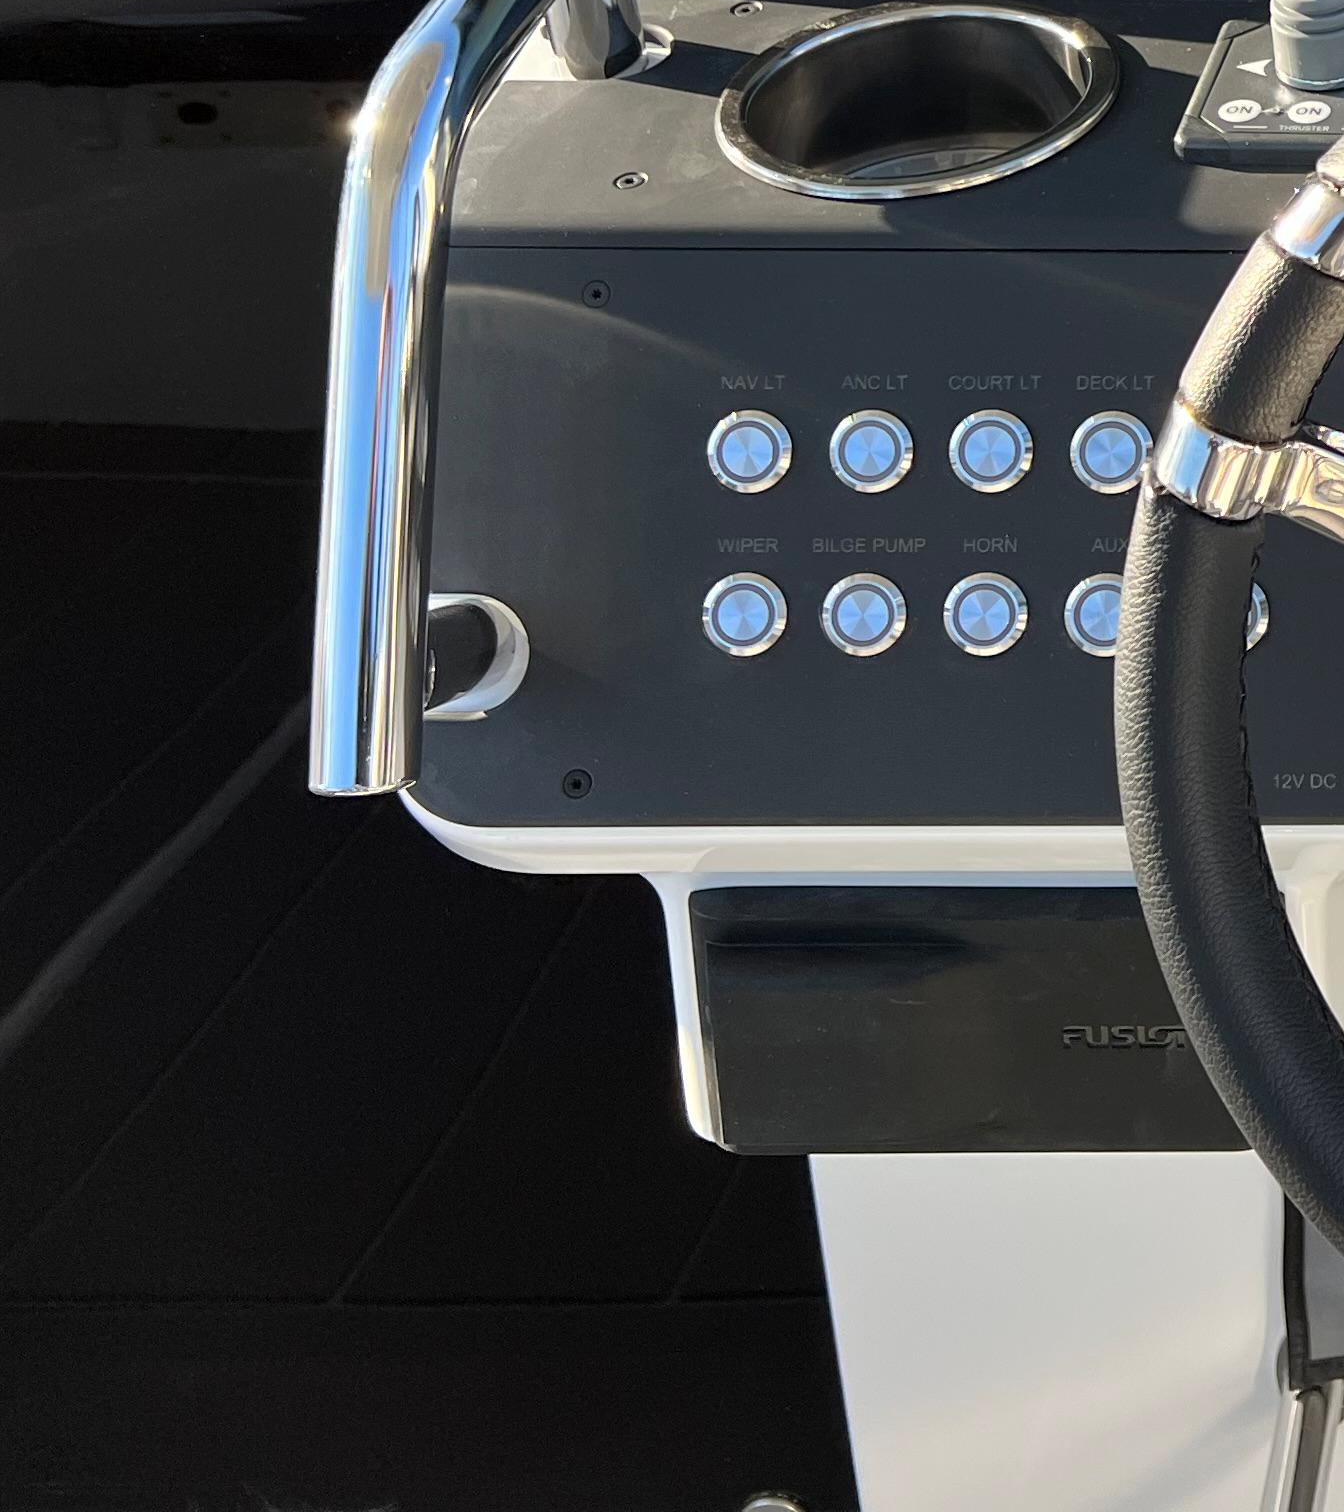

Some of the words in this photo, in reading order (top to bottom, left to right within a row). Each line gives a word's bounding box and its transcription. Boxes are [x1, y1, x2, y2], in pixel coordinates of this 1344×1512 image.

[1226, 106, 1254, 114] ON
[1295, 107, 1322, 116] ON
[720, 374, 759, 390] NAV
[764, 375, 785, 390] LT
[841, 374, 882, 390] ANC
[887, 375, 908, 390] LT
[948, 374, 1015, 390] COURT
[1020, 375, 1041, 390] LT
[1076, 375, 1127, 390] DECK
[1133, 375, 1154, 390] LT
[717, 538, 779, 553] WIPER
[813, 538, 868, 553] BILGE
[872, 538, 926, 553] PUMP
[963, 538, 1018, 553] HORN
[1272, 773, 1305, 789] 12V
[1310, 773, 1337, 789] DC
